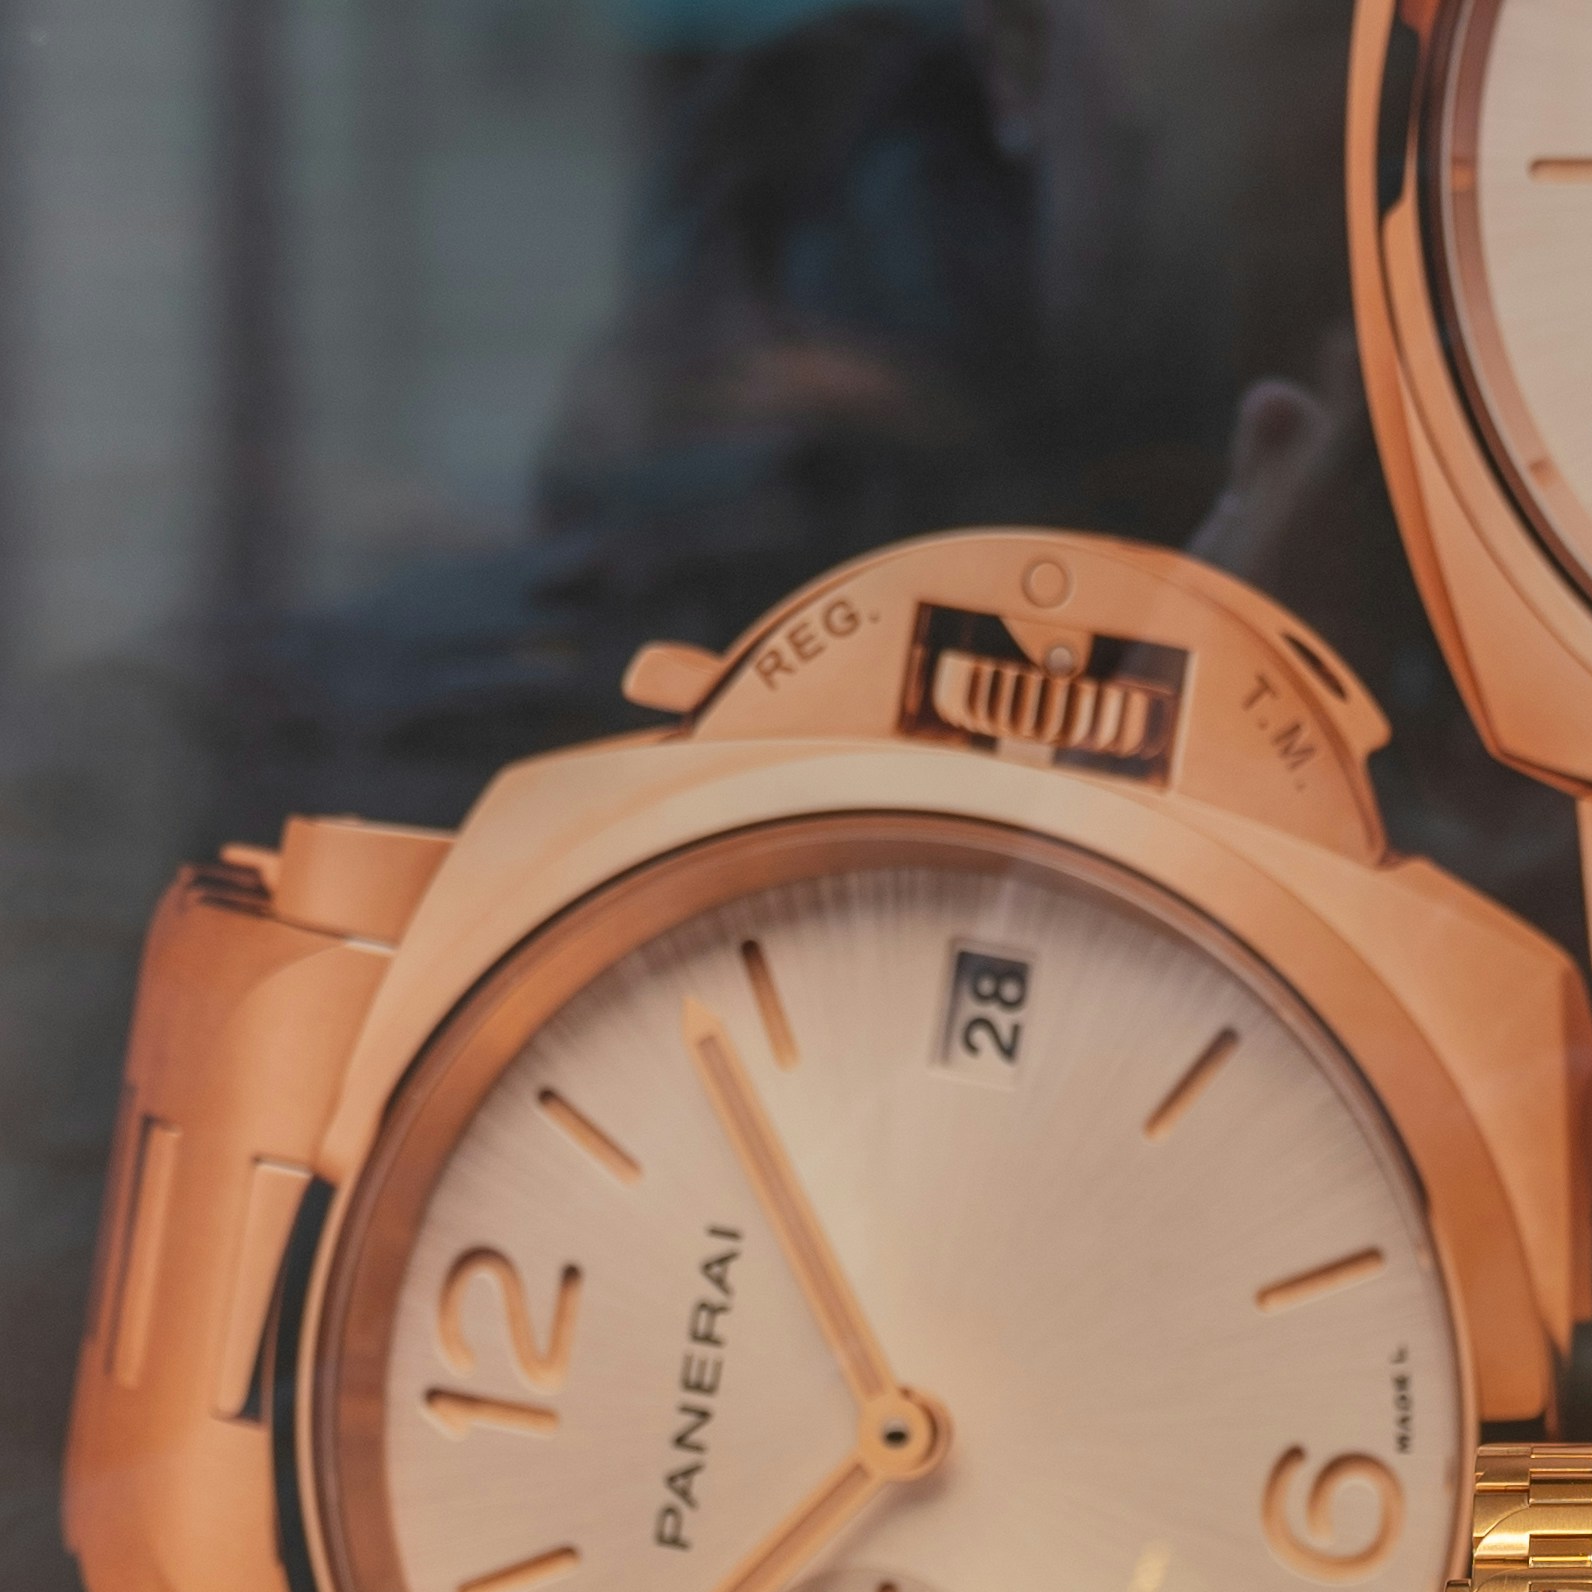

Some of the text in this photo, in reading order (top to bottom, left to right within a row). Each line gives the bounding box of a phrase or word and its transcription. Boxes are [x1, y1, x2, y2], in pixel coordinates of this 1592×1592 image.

[753, 596, 882, 692] REG.
[1238, 673, 1322, 794] T.M.
[962, 964, 1029, 1065] 28
[424, 1244, 582, 1438] 12
[655, 1225, 743, 1552] PANERAI
[1260, 1446, 1403, 1583] 6
